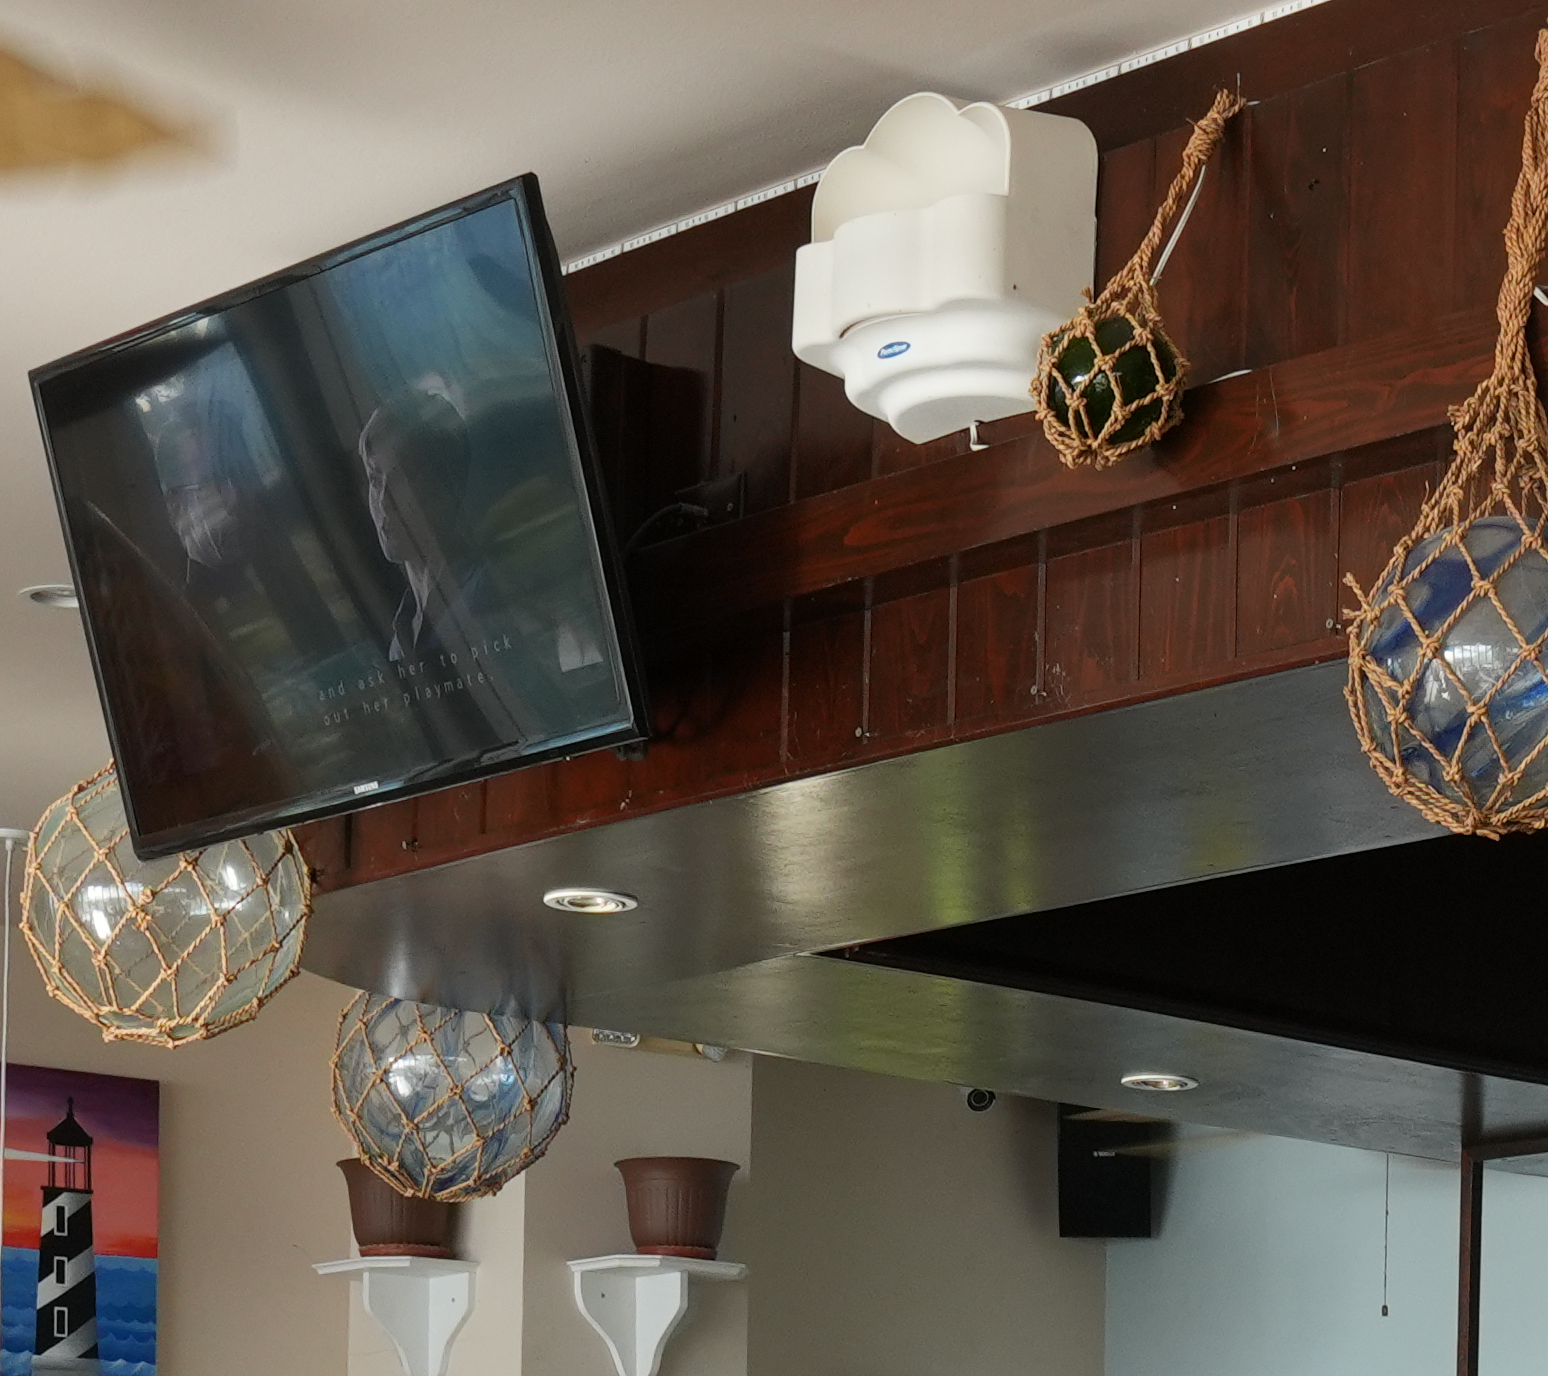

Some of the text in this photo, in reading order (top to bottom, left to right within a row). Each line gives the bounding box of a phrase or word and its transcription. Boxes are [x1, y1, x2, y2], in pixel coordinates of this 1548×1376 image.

[319, 634, 512, 701] and ask her to pick
[323, 672, 494, 726] out her playmate.
